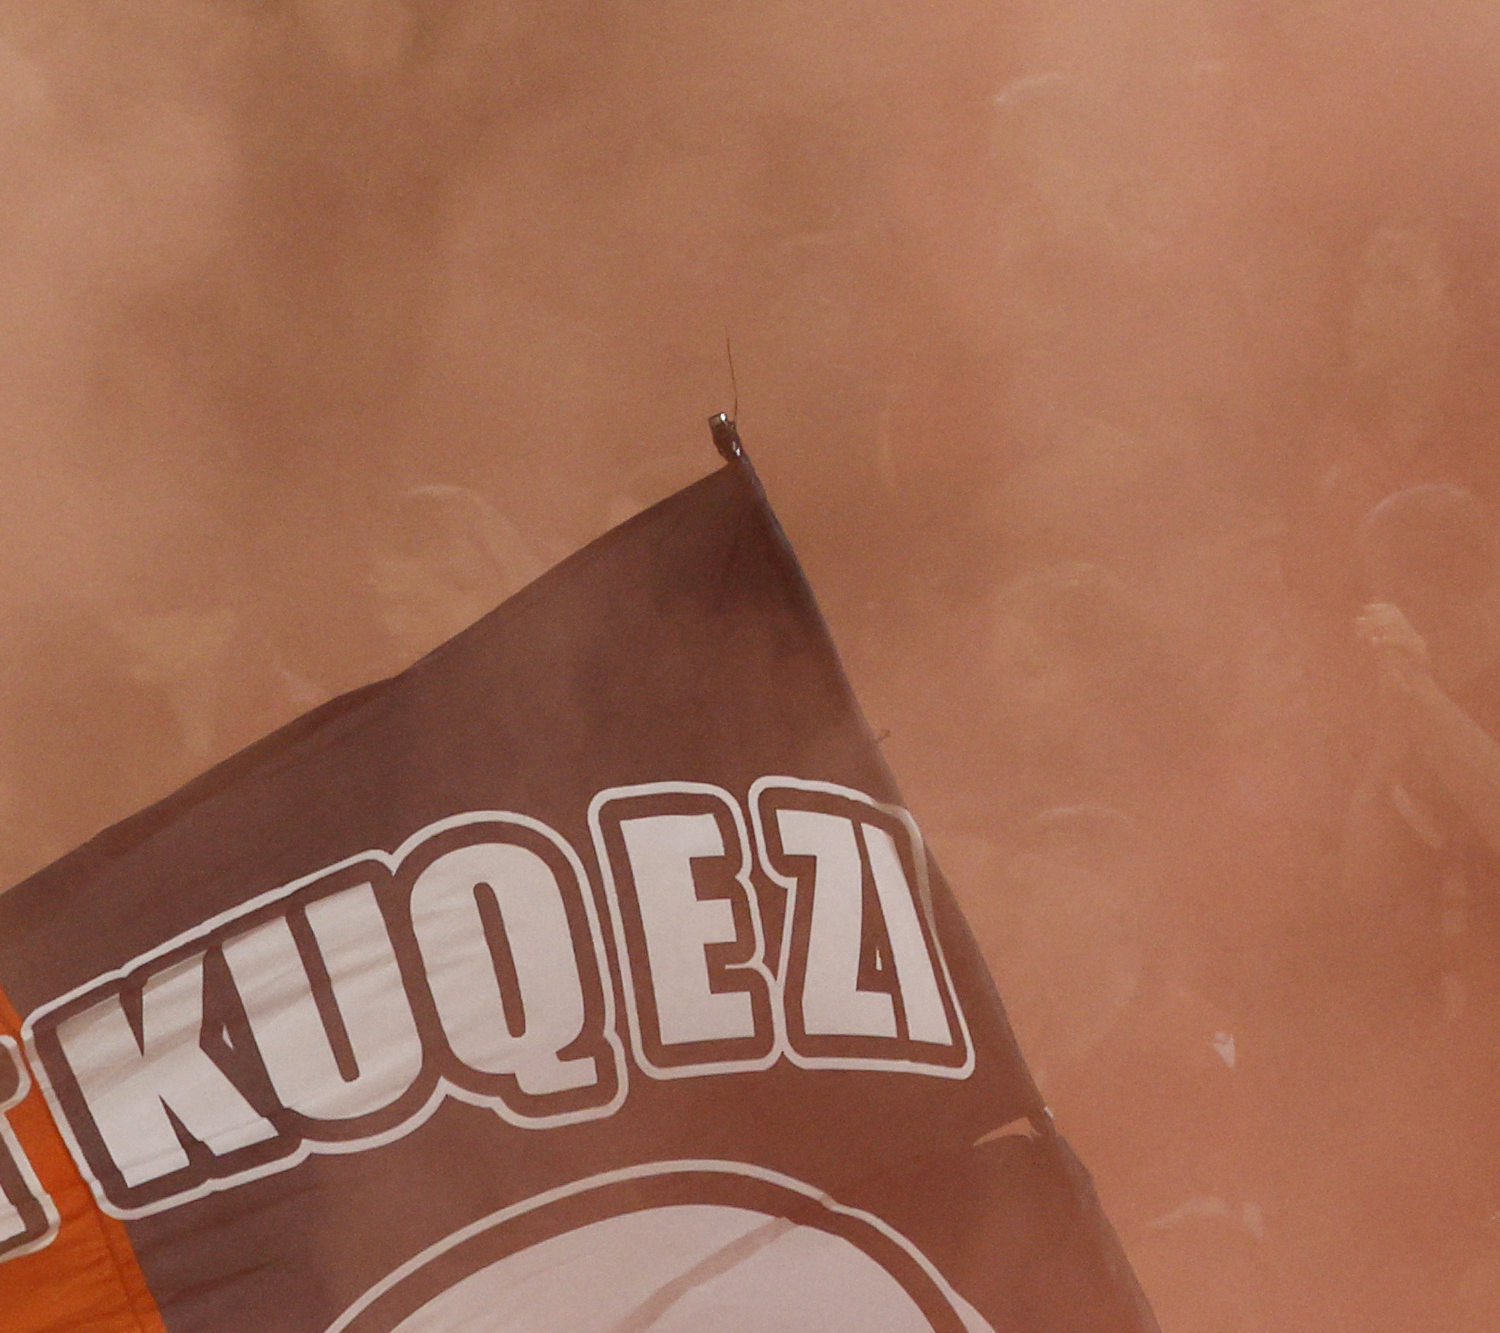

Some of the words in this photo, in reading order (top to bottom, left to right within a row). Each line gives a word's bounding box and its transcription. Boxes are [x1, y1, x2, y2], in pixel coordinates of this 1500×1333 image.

[21, 810, 627, 1220] KUQ
[588, 780, 782, 1080] E
[748, 775, 975, 1079] ZI
